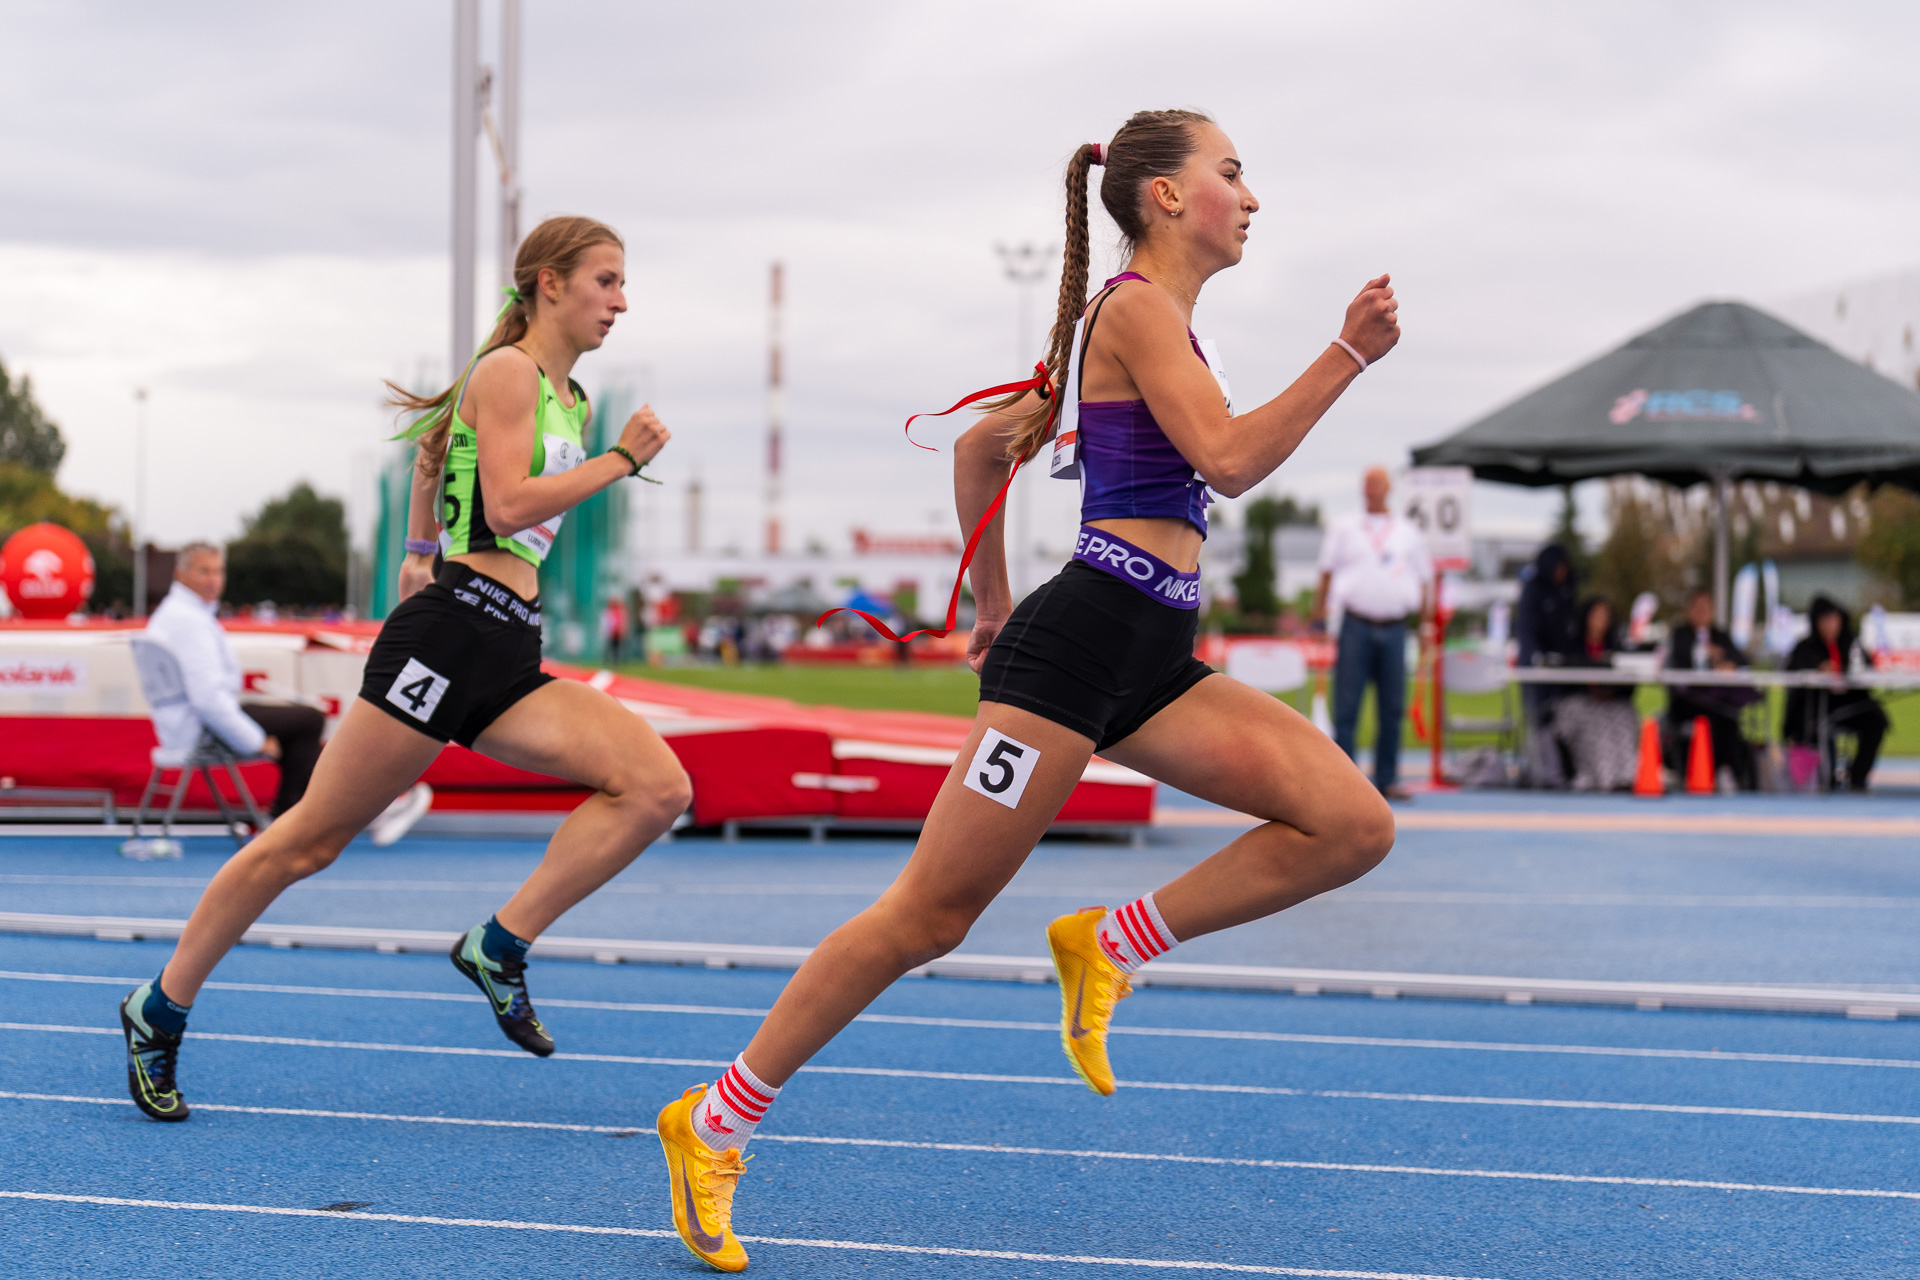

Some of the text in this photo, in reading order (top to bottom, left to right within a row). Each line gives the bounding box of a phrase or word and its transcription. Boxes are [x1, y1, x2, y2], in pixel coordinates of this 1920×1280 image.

[1084, 536, 1155, 581] PRO
[1154, 575, 1196, 602] NIKE
[467, 577, 511, 606] NIKE
[507, 599, 529, 622] PRO
[400, 675, 435, 712] 4
[979, 739, 1024, 793] 5
